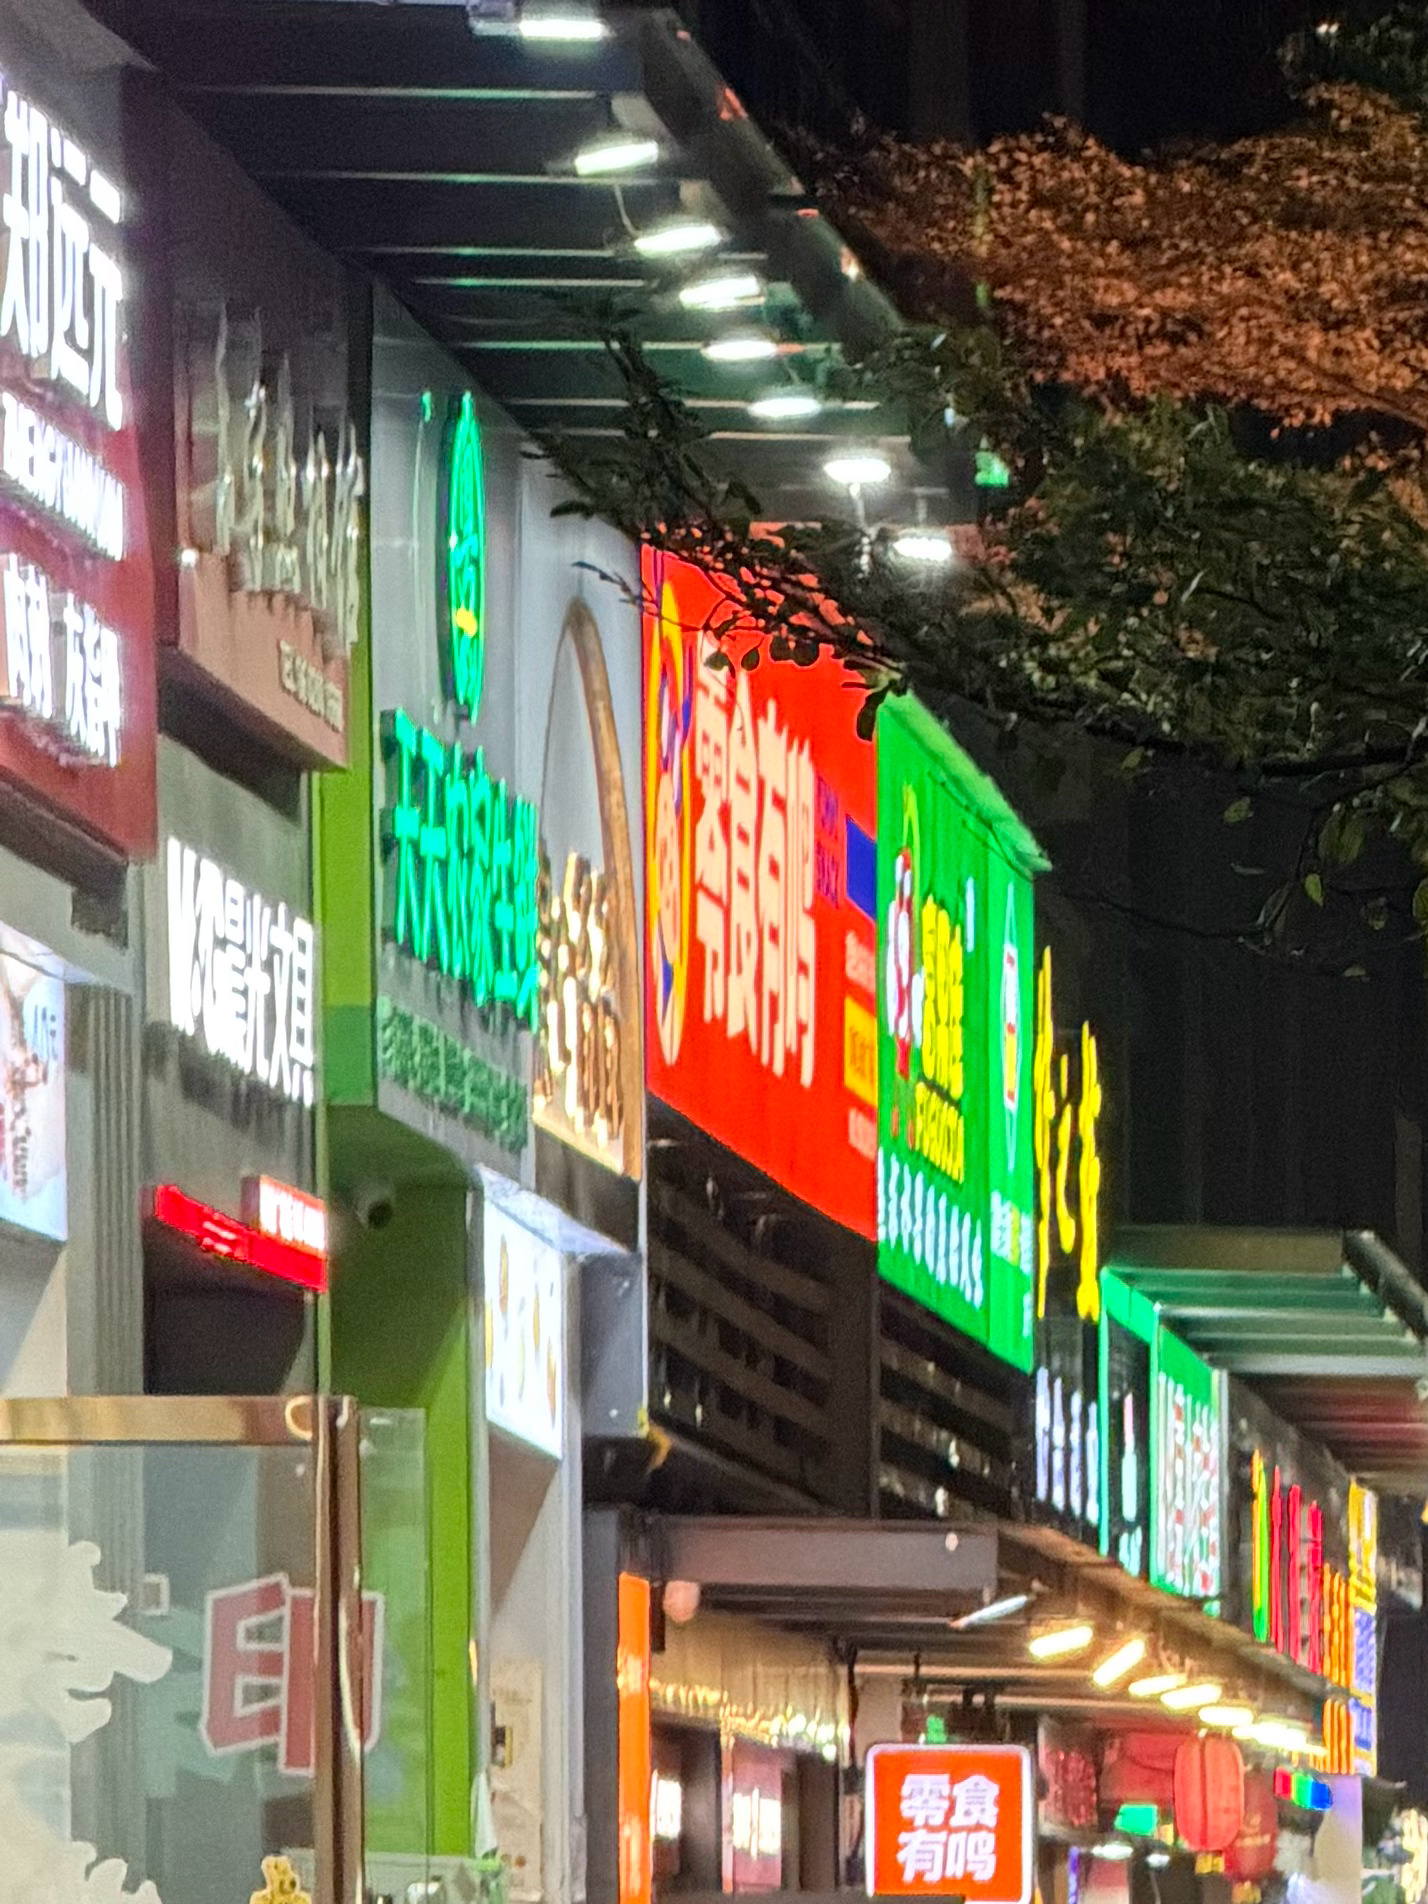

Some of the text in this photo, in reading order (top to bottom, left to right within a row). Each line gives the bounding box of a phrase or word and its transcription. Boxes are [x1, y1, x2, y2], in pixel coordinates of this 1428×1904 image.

[1, 88, 123, 431] 郑远元
[396, 703, 538, 1034] 天天农家生鲜
[896, 1829, 996, 1884] 有鸣
[900, 1773, 999, 1827] 零食
